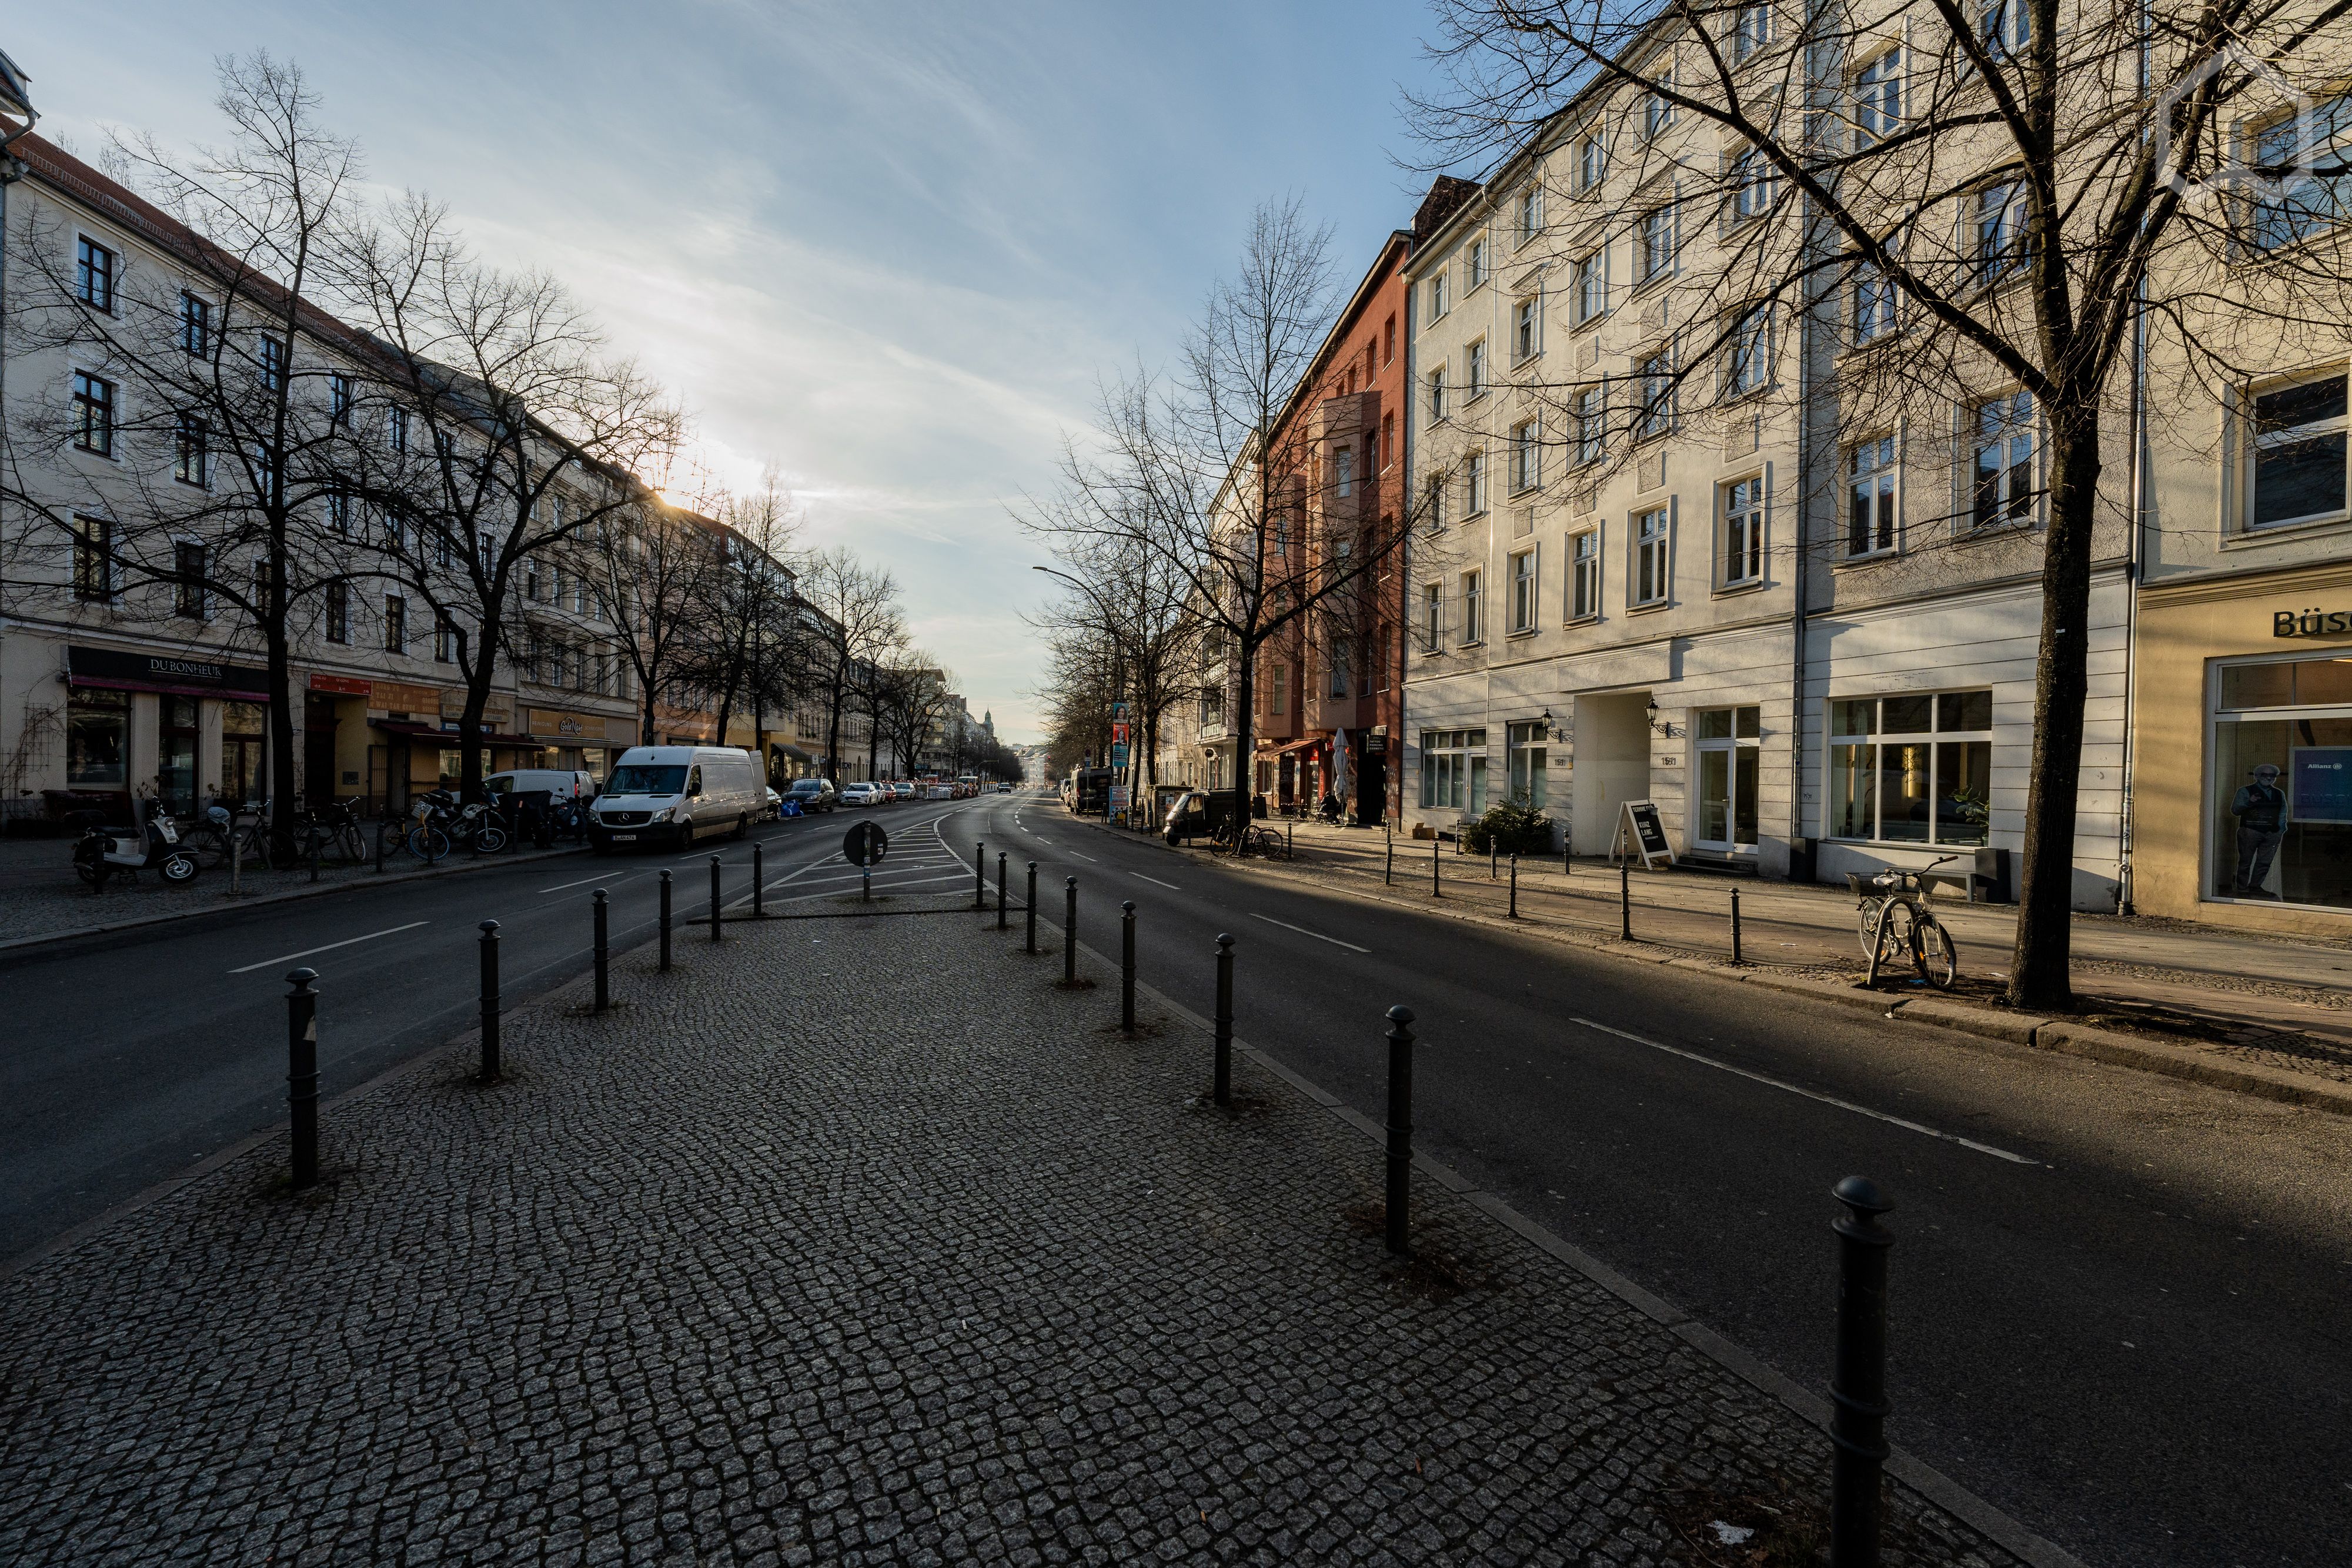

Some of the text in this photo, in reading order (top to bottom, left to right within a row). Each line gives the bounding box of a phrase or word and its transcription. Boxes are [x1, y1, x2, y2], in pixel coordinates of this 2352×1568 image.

[2273, 608, 2352, 637] Büs
[151, 659, 222, 676] DU BONHEUR
